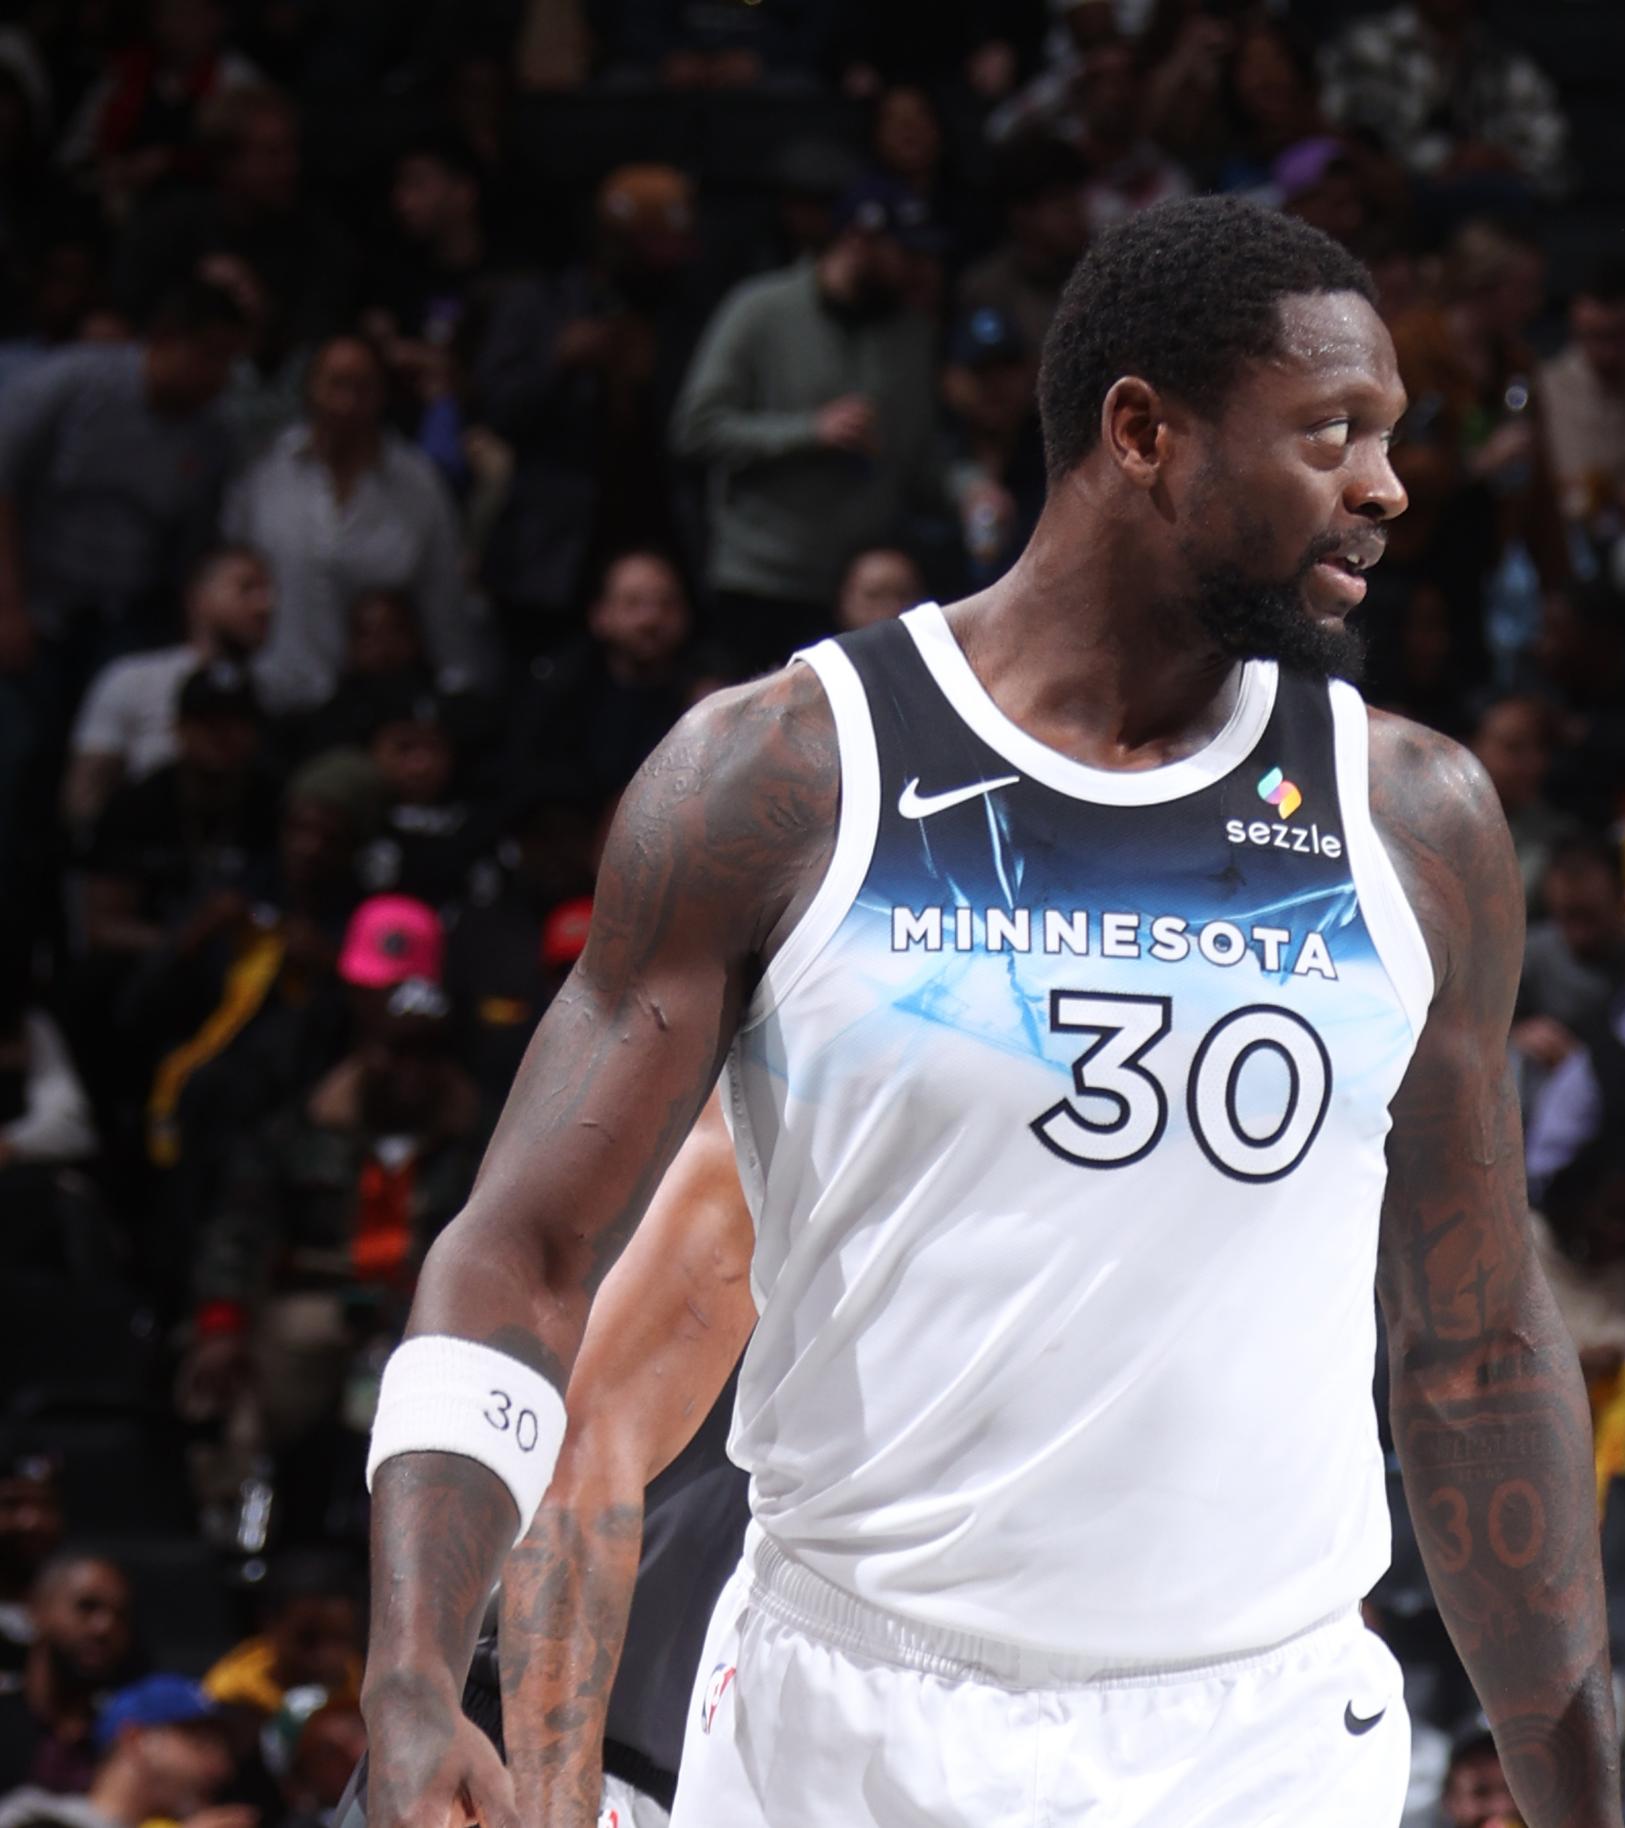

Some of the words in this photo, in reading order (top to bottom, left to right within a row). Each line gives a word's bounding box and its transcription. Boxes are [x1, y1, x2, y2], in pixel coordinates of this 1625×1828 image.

[1225, 819, 1342, 859] sezzle
[890, 906, 1340, 981] MINNESOTA
[1028, 988, 1333, 1185] 30
[483, 1389, 538, 1453] 30
[1425, 1477, 1545, 1574] 30
